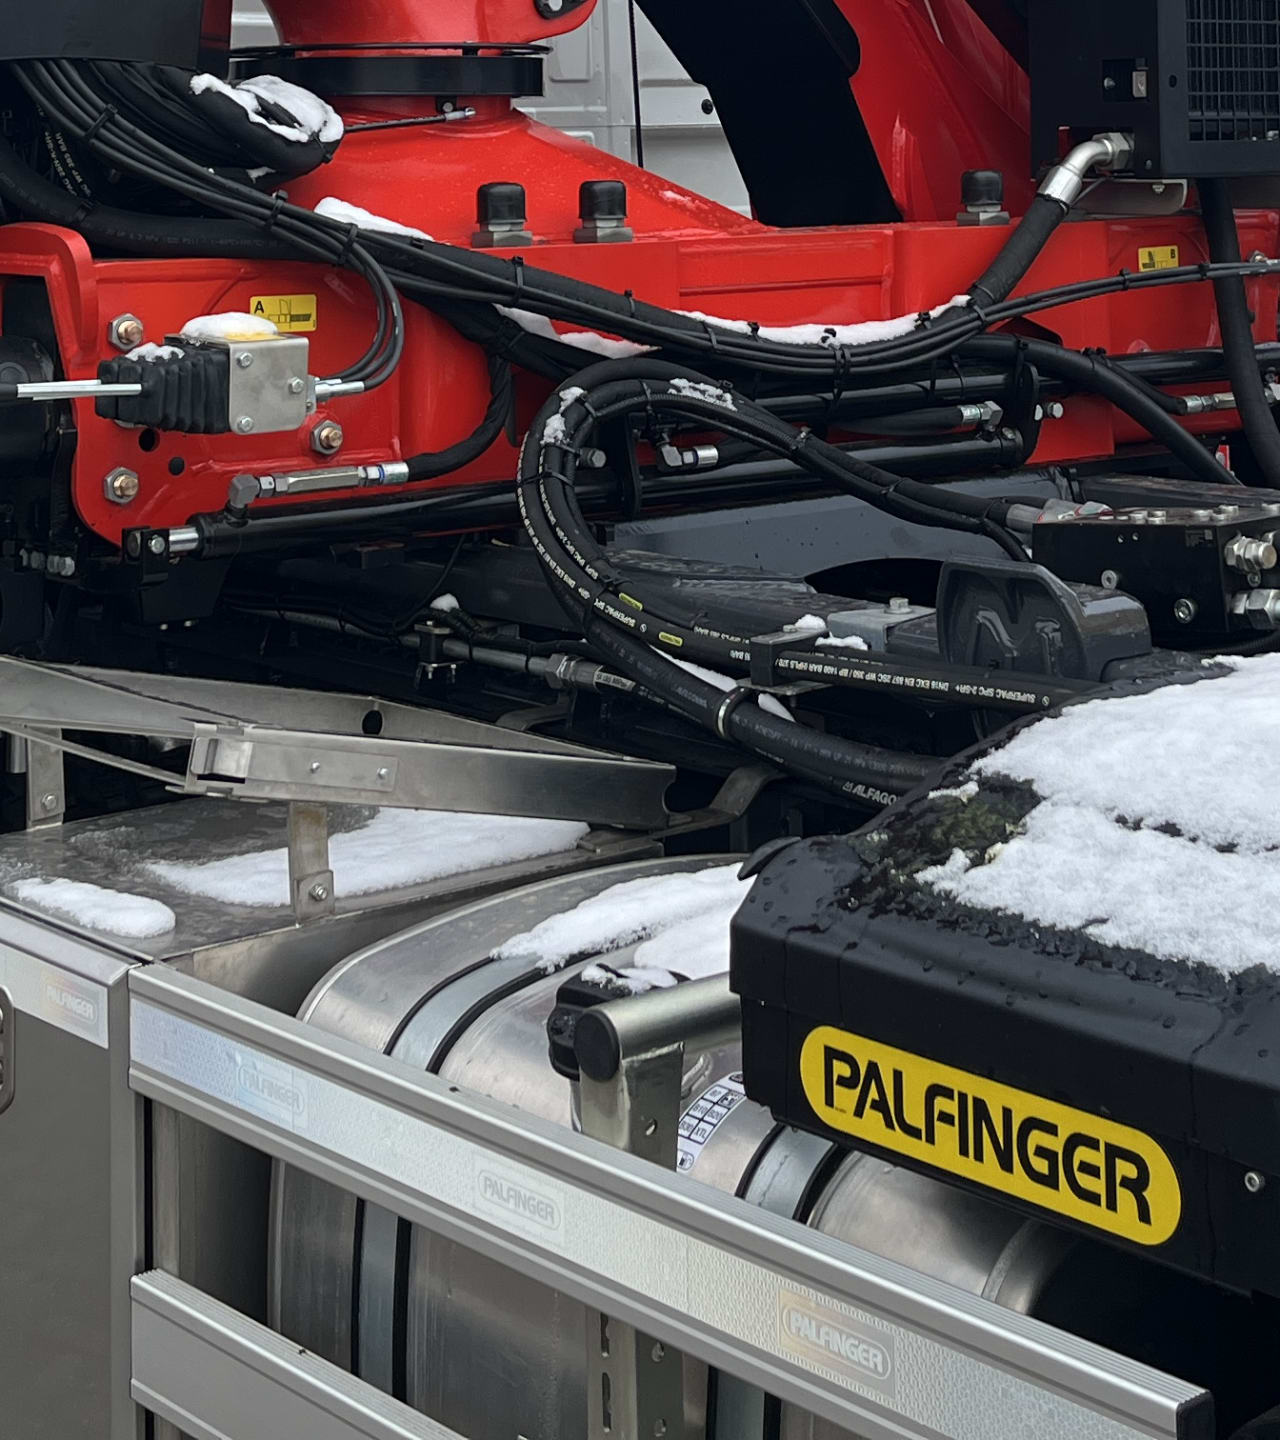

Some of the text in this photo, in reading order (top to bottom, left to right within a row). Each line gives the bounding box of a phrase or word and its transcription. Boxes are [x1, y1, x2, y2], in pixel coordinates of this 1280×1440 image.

[1170, 248, 1176, 259] B
[254, 300, 265, 314] A
[852, 783, 898, 807] ALFAGO
[822, 1044, 1152, 1226] PALFINGER
[483, 1175, 555, 1221] PALFINGER
[789, 1310, 884, 1374] PALFINGER
